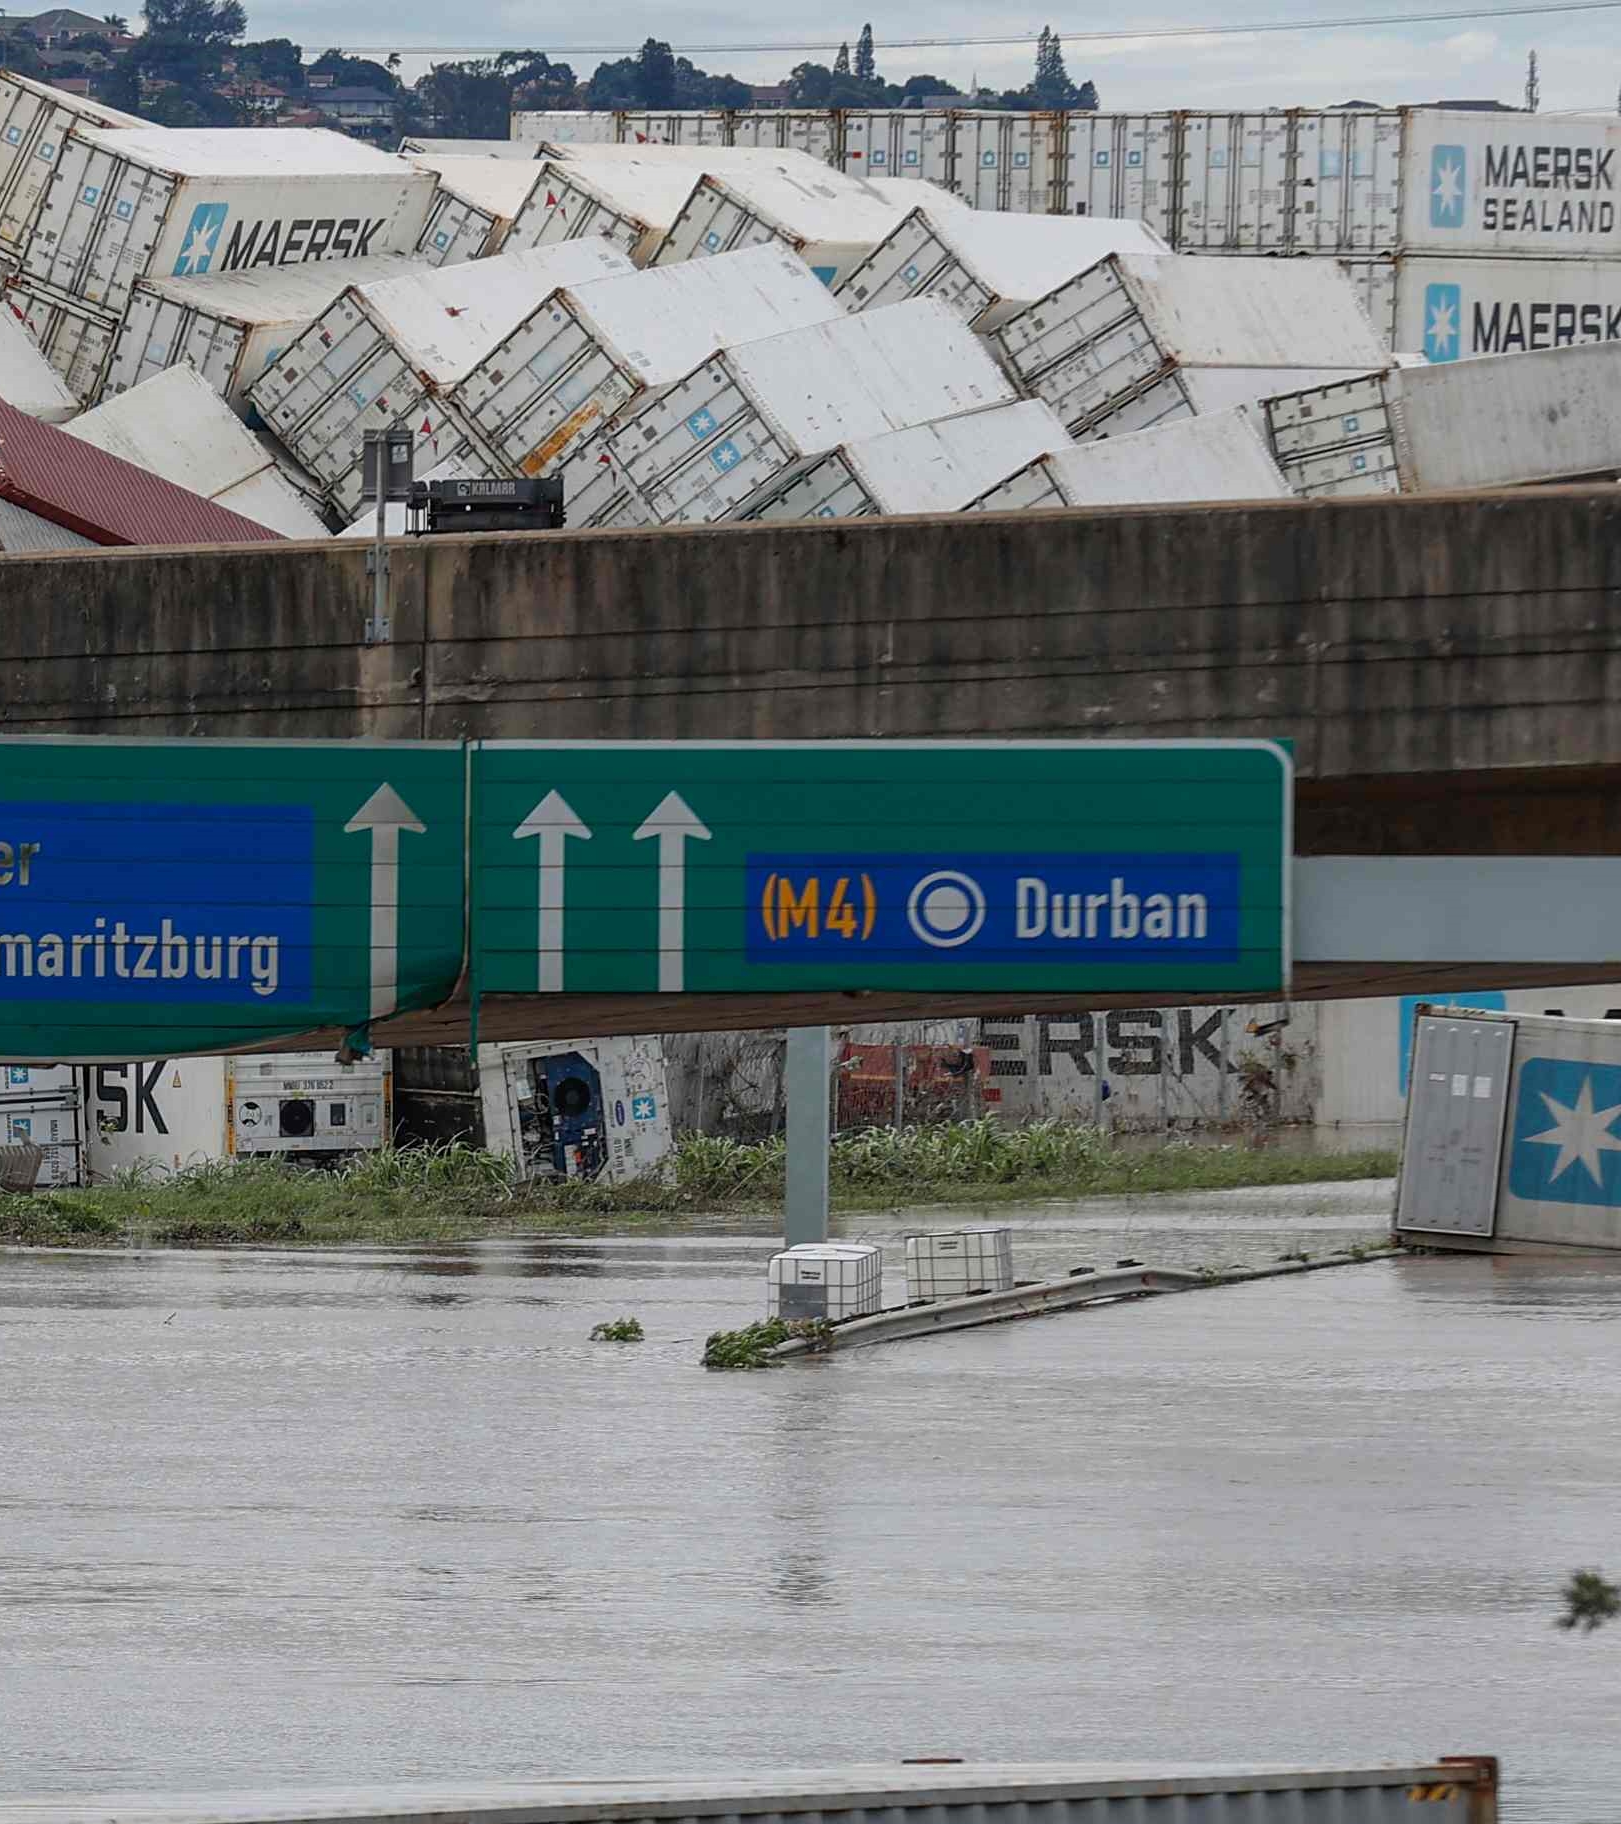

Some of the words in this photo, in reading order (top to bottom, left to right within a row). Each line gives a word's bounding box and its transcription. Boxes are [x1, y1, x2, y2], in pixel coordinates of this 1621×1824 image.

[1485, 145, 1615, 189] MAERSK
[1483, 198, 1614, 233] SEALAND
[220, 218, 387, 272] MAERSK
[471, 481, 516, 496] KALMAR
[761, 871, 877, 942] (M4)
[1015, 877, 1208, 940] Durban
